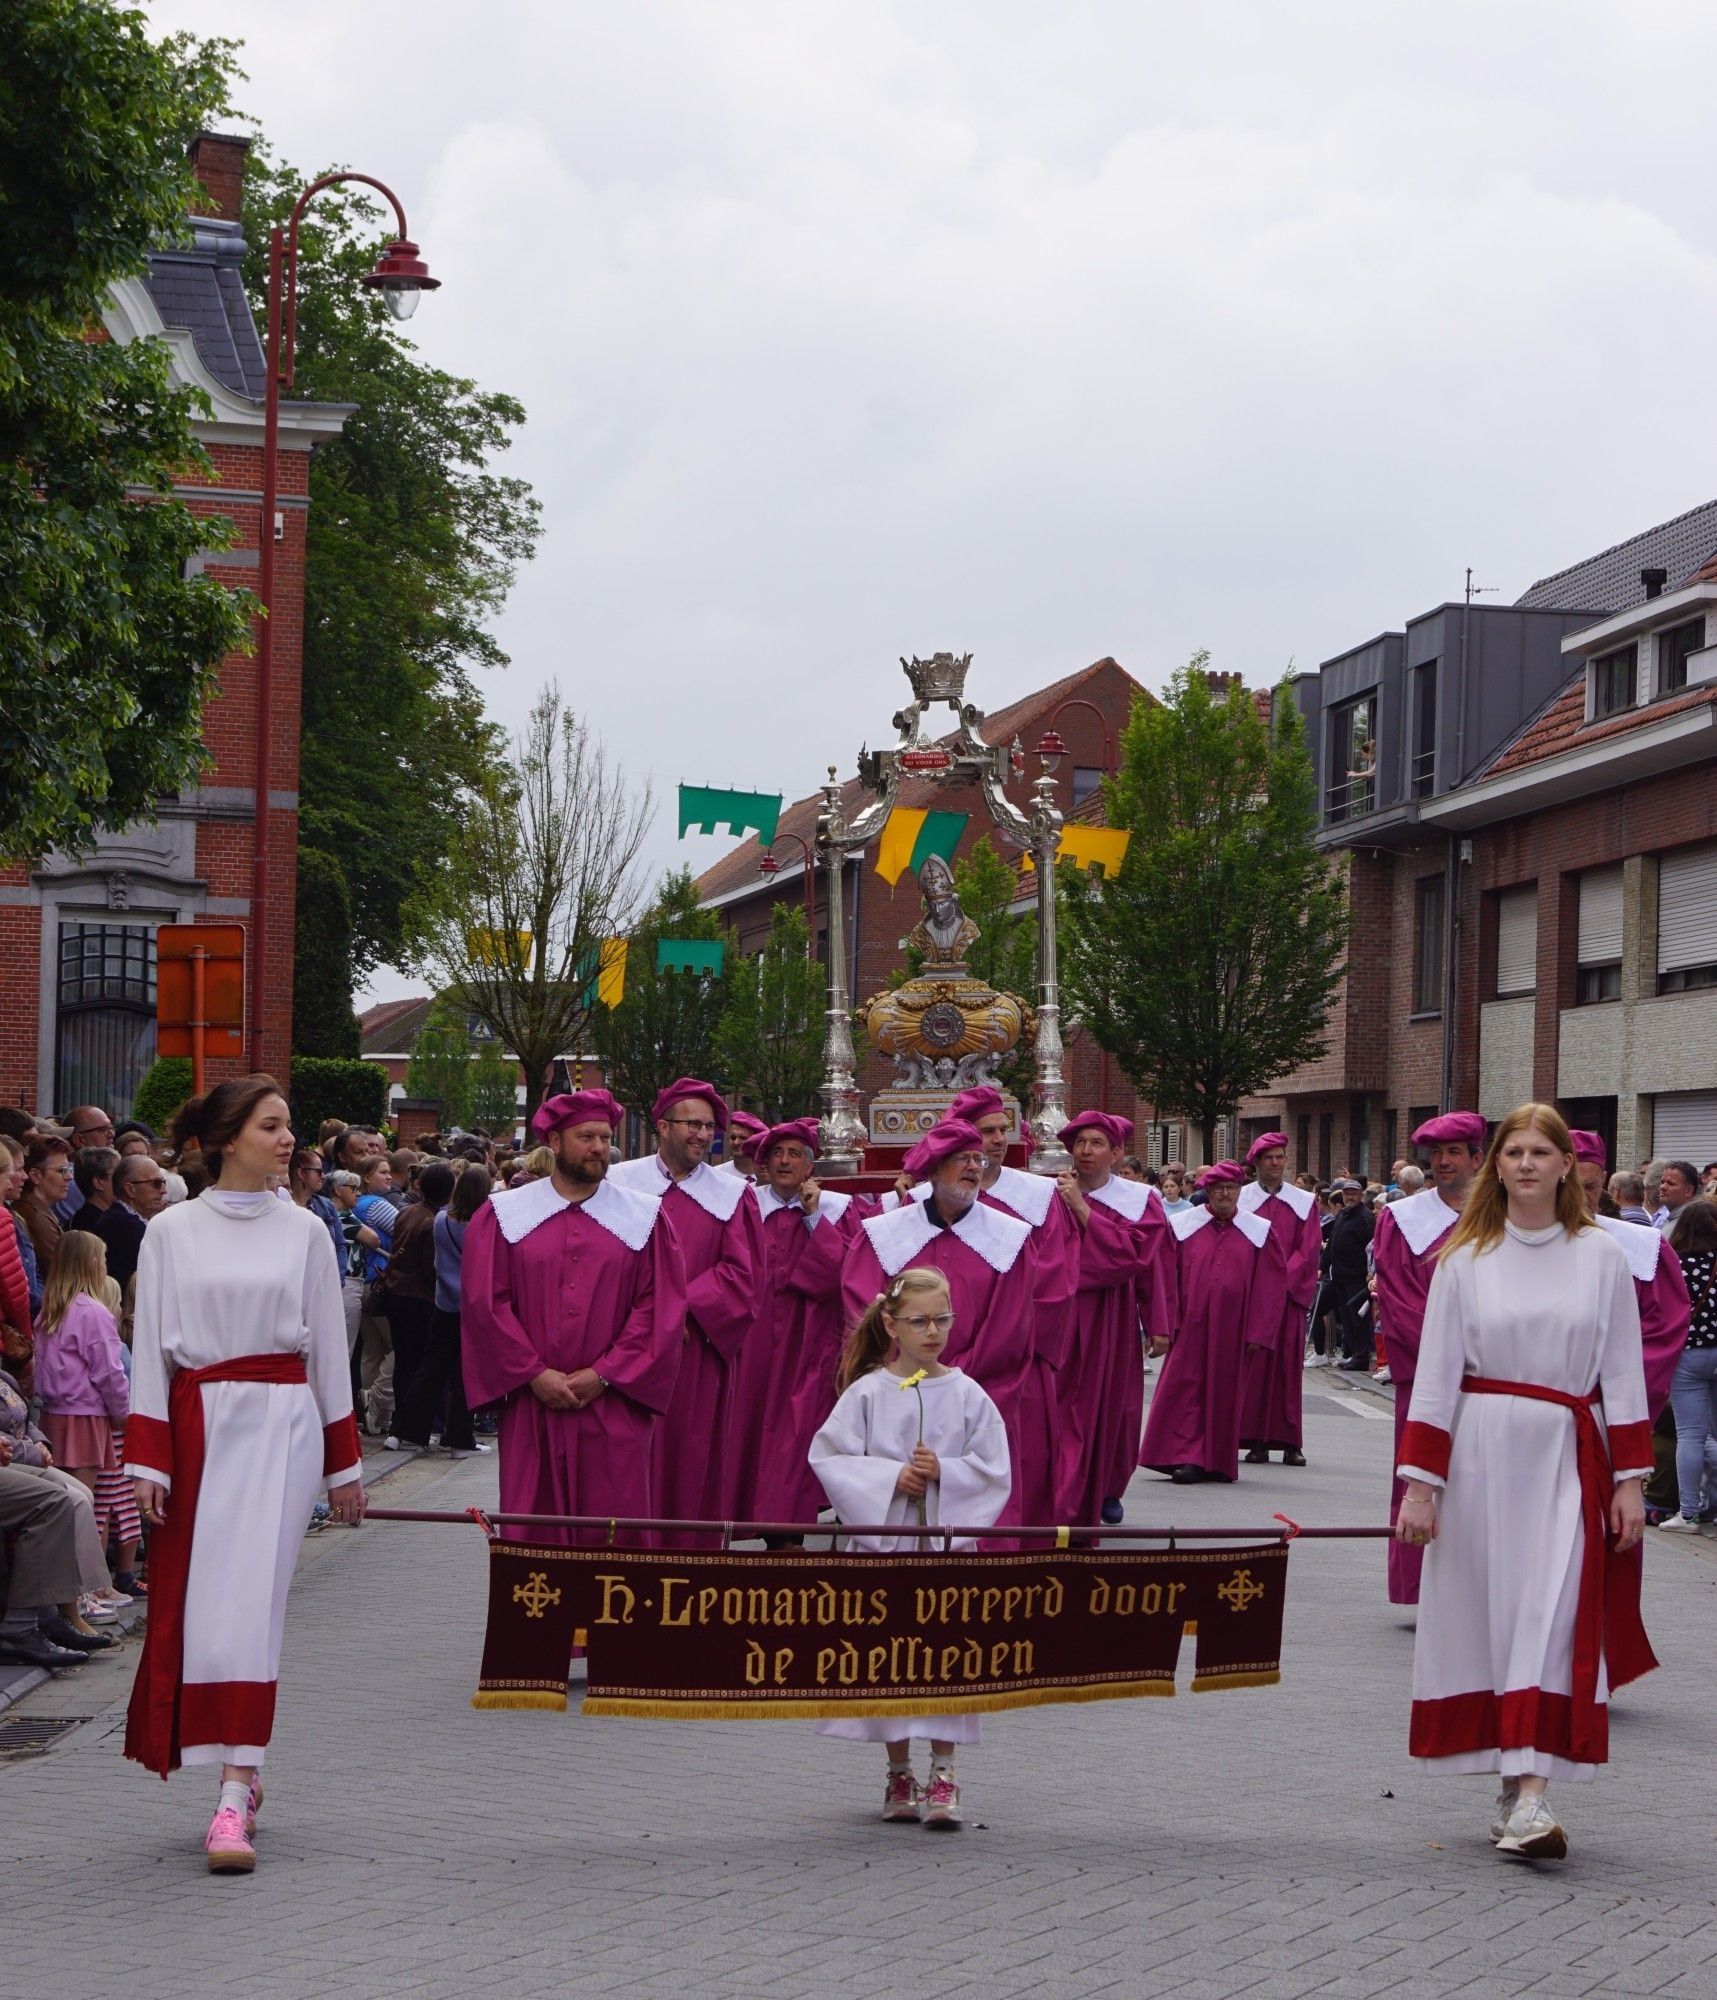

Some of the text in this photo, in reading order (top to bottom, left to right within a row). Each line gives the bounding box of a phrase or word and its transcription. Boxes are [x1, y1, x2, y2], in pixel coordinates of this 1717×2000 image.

[914, 1575, 1064, 1625] vereerd
[1088, 1576, 1187, 1616] door
[746, 1636, 1034, 1685] de edellieden
